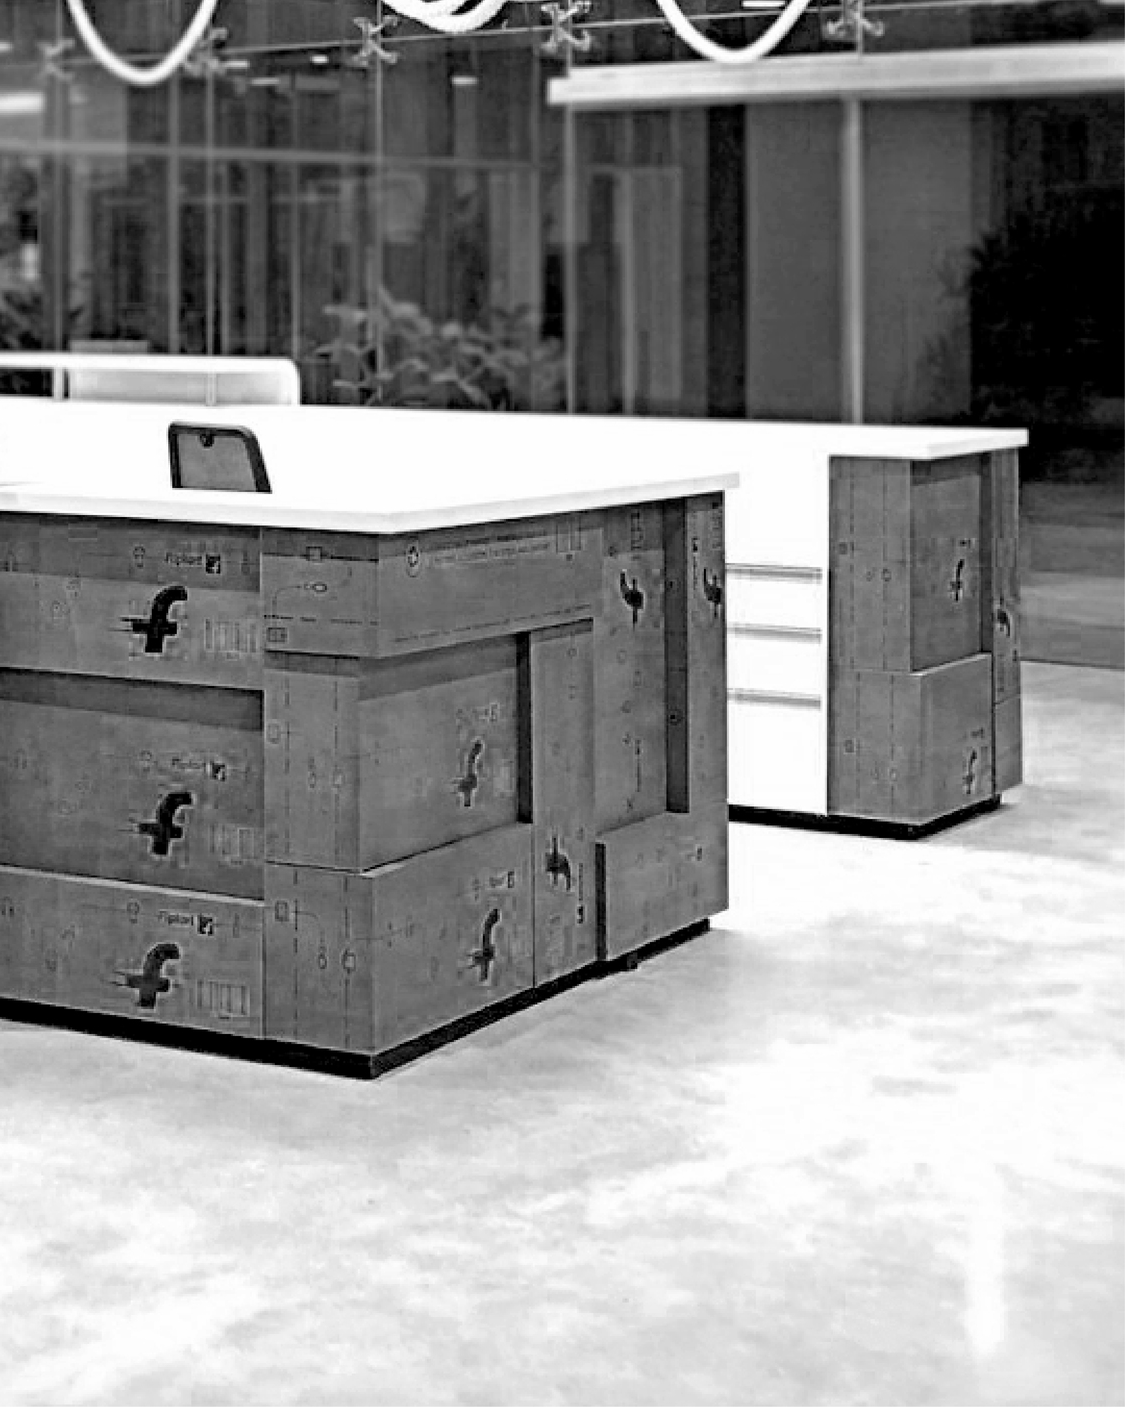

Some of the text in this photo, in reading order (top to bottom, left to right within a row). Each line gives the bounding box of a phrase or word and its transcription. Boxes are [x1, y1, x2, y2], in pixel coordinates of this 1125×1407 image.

[116, 585, 188, 653] f
[123, 792, 192, 855] f
[113, 943, 180, 1009] f
